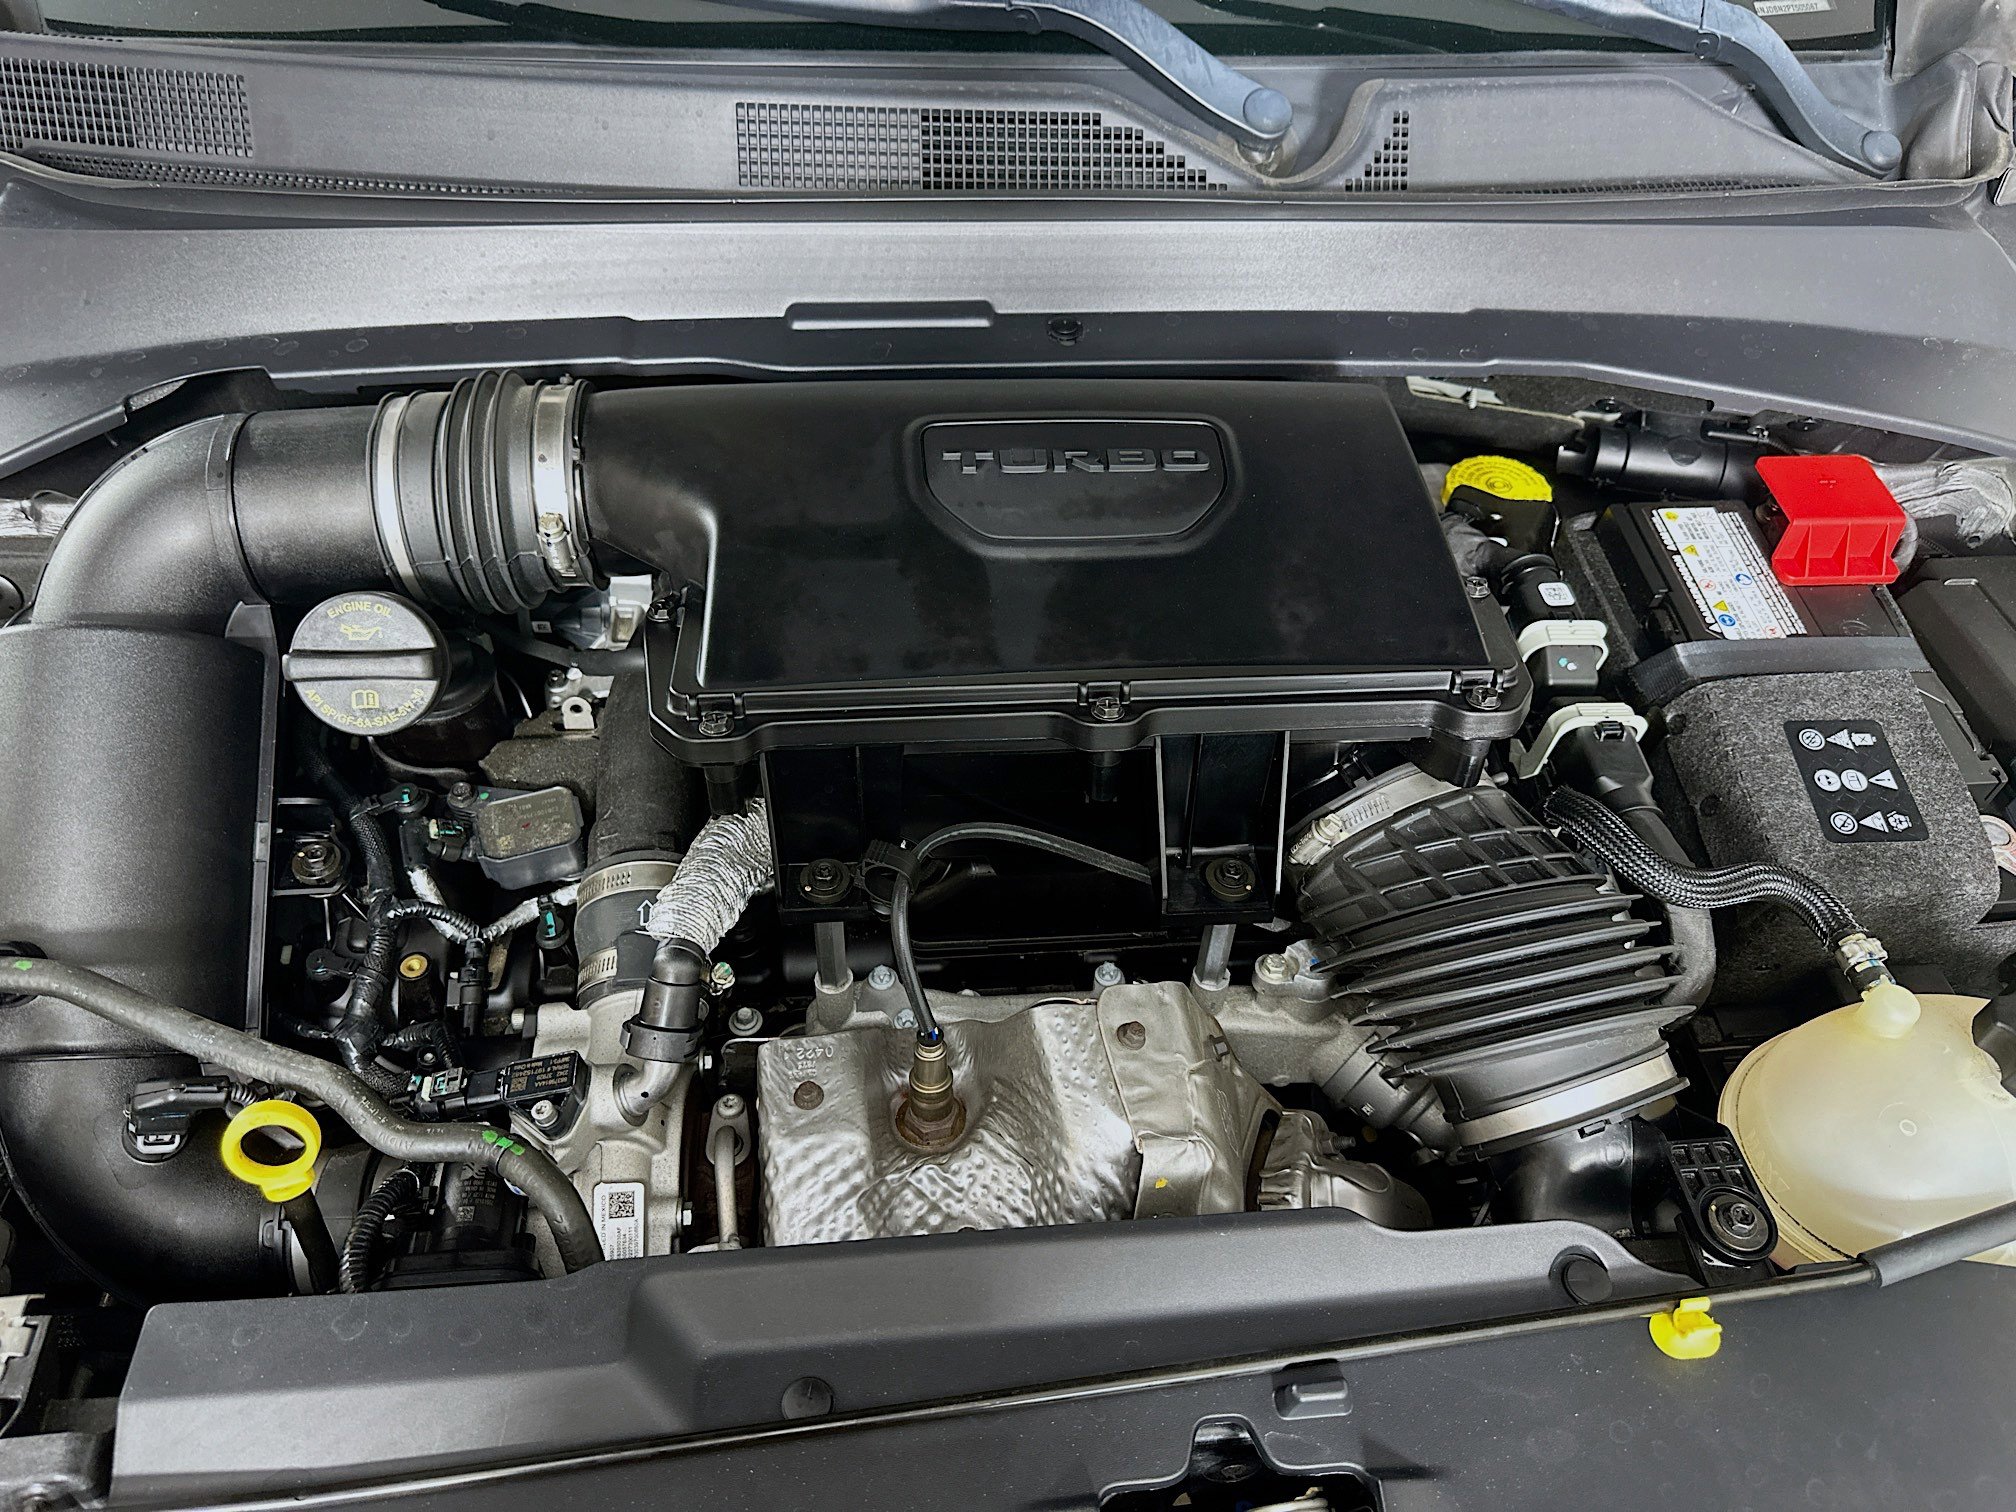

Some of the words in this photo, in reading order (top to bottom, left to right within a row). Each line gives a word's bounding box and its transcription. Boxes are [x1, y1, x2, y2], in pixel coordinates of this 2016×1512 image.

[942, 448, 1210, 474] TURBO
[327, 601, 372, 619] ENGINE
[374, 604, 392, 618] OIL
[305, 689, 322, 707] API
